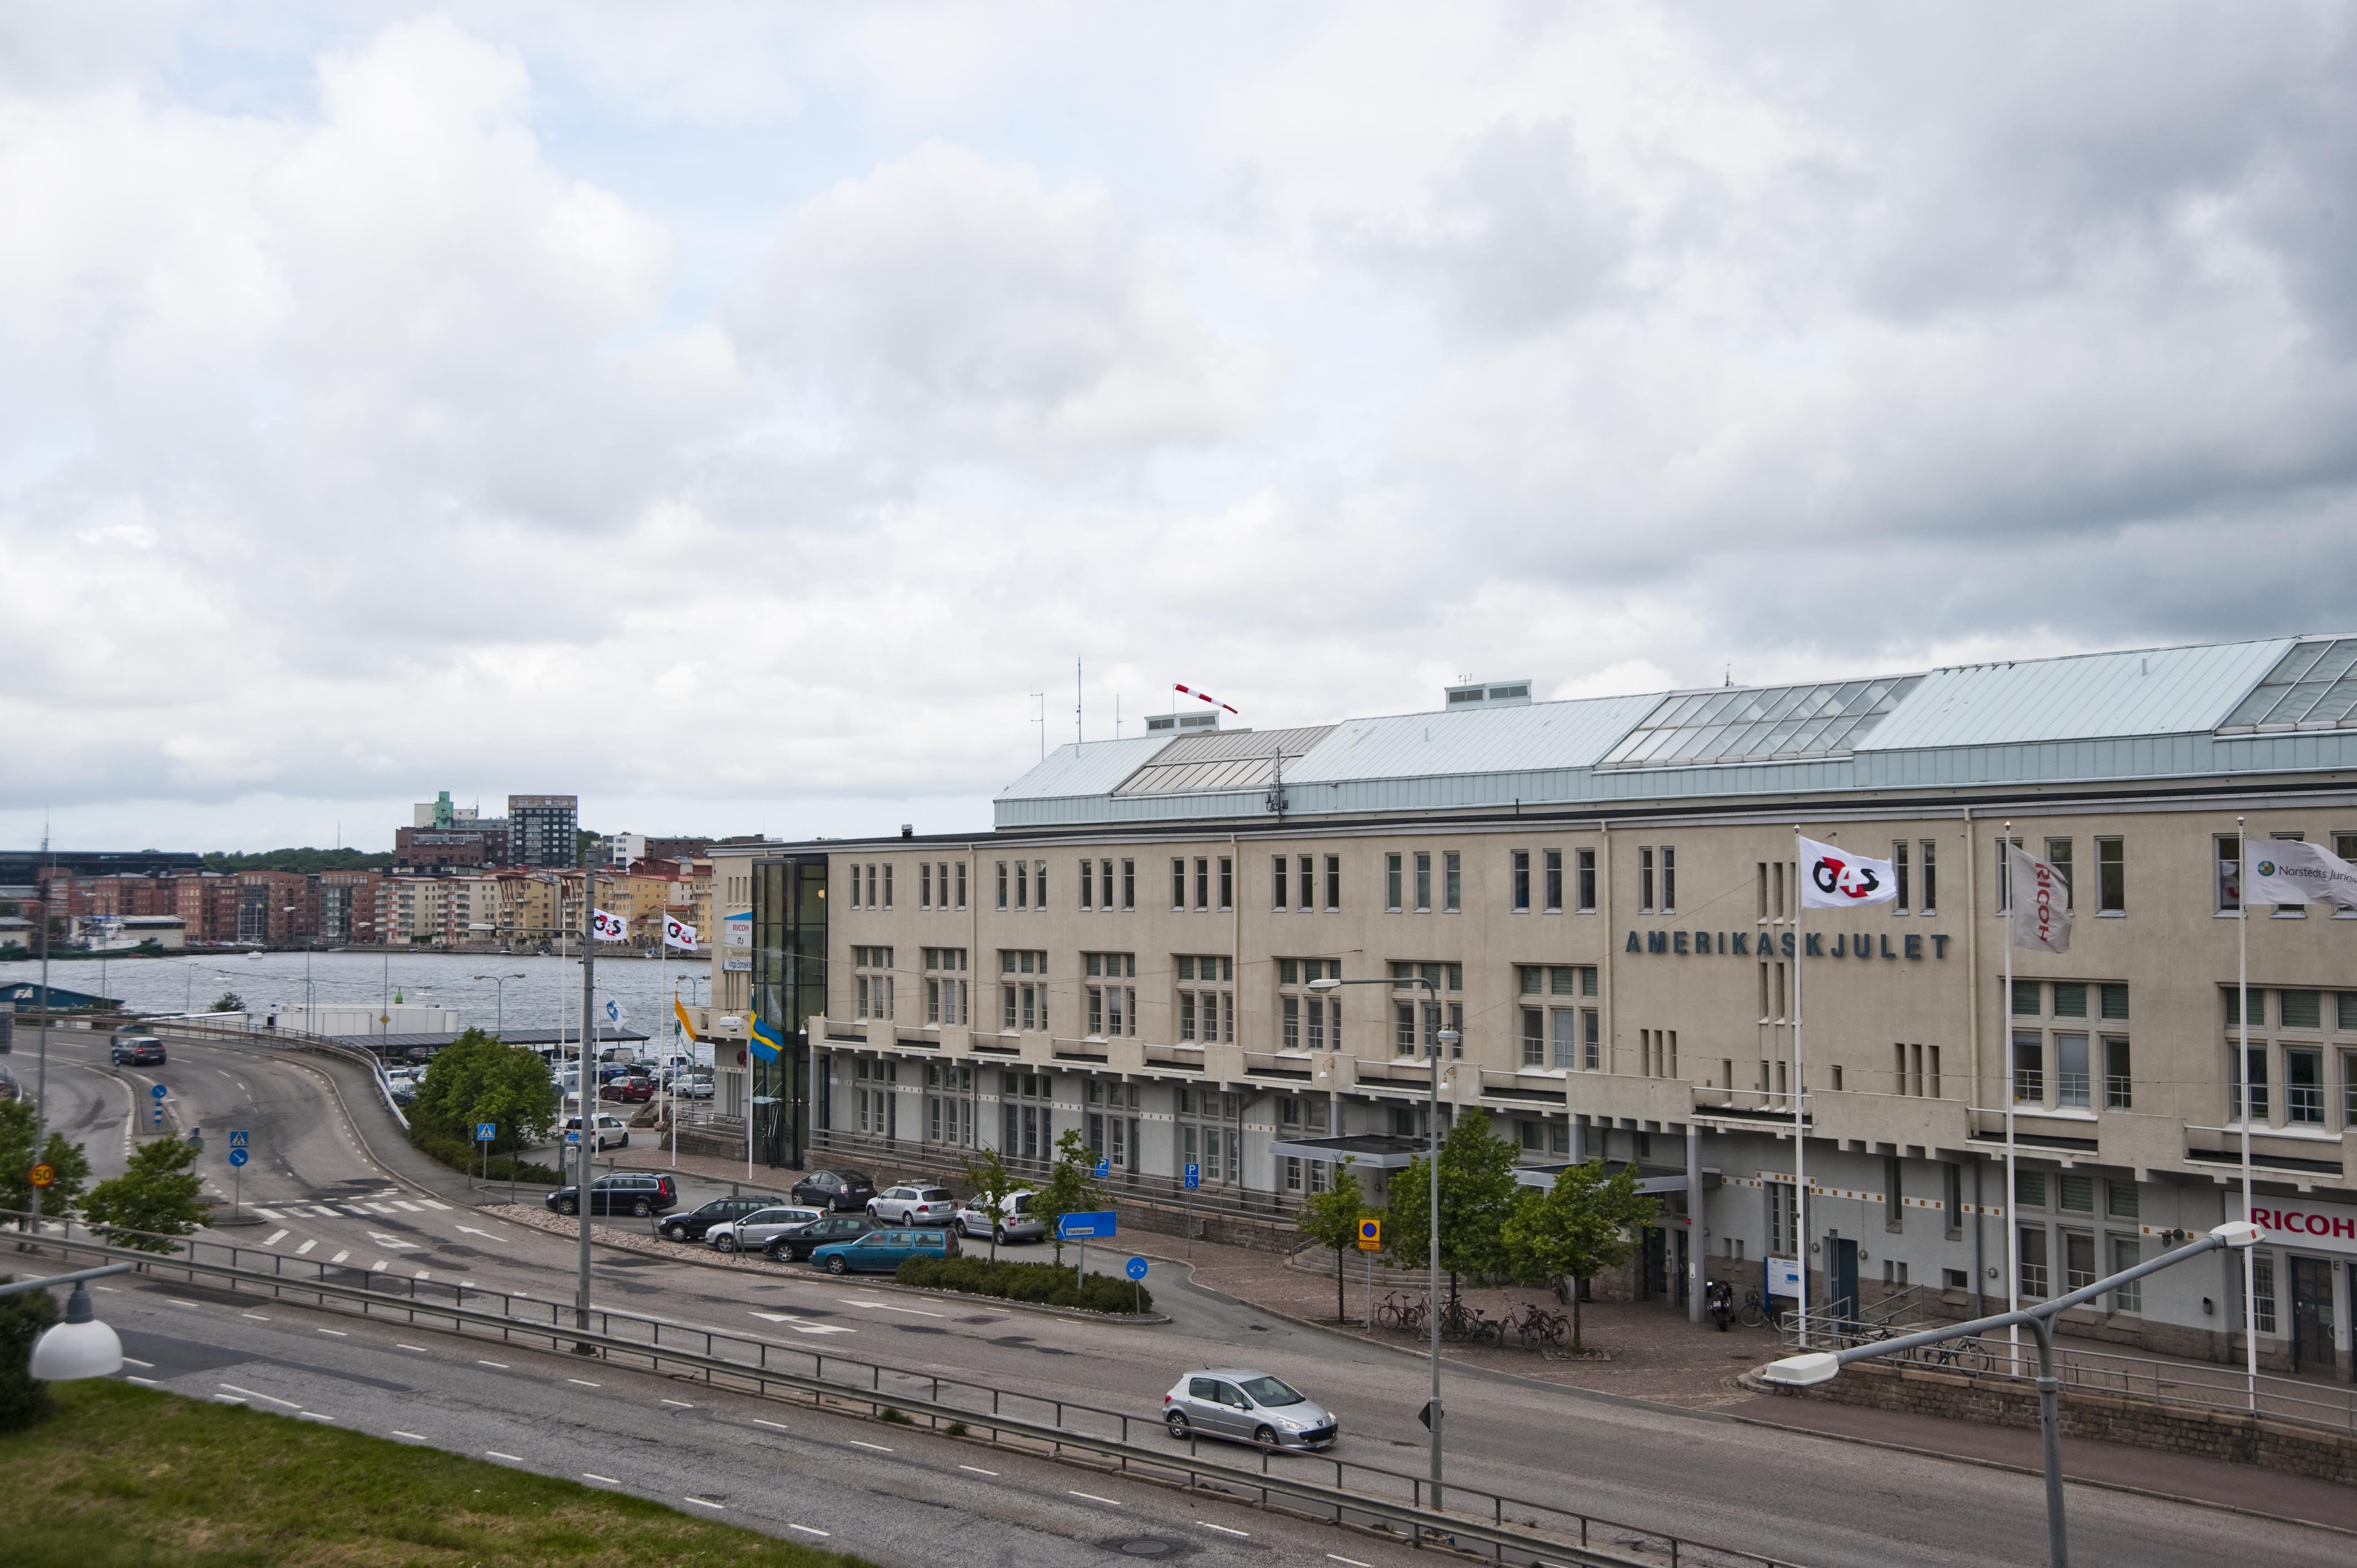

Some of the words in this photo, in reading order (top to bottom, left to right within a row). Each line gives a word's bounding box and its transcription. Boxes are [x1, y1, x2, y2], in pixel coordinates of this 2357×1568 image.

[1813, 857, 1879, 898] G4S
[2279, 865, 2327, 878] Norstedts
[2035, 863, 2051, 942] RICOH
[1625, 931, 1948, 959] AMERIKASKJULET
[14, 987, 33, 998] FÅ
[35, 1169, 51, 1180] 50
[1189, 1164, 1196, 1174] P
[2251, 1208, 2355, 1239] RICOH
[2333, 1260, 2340, 1271] E
